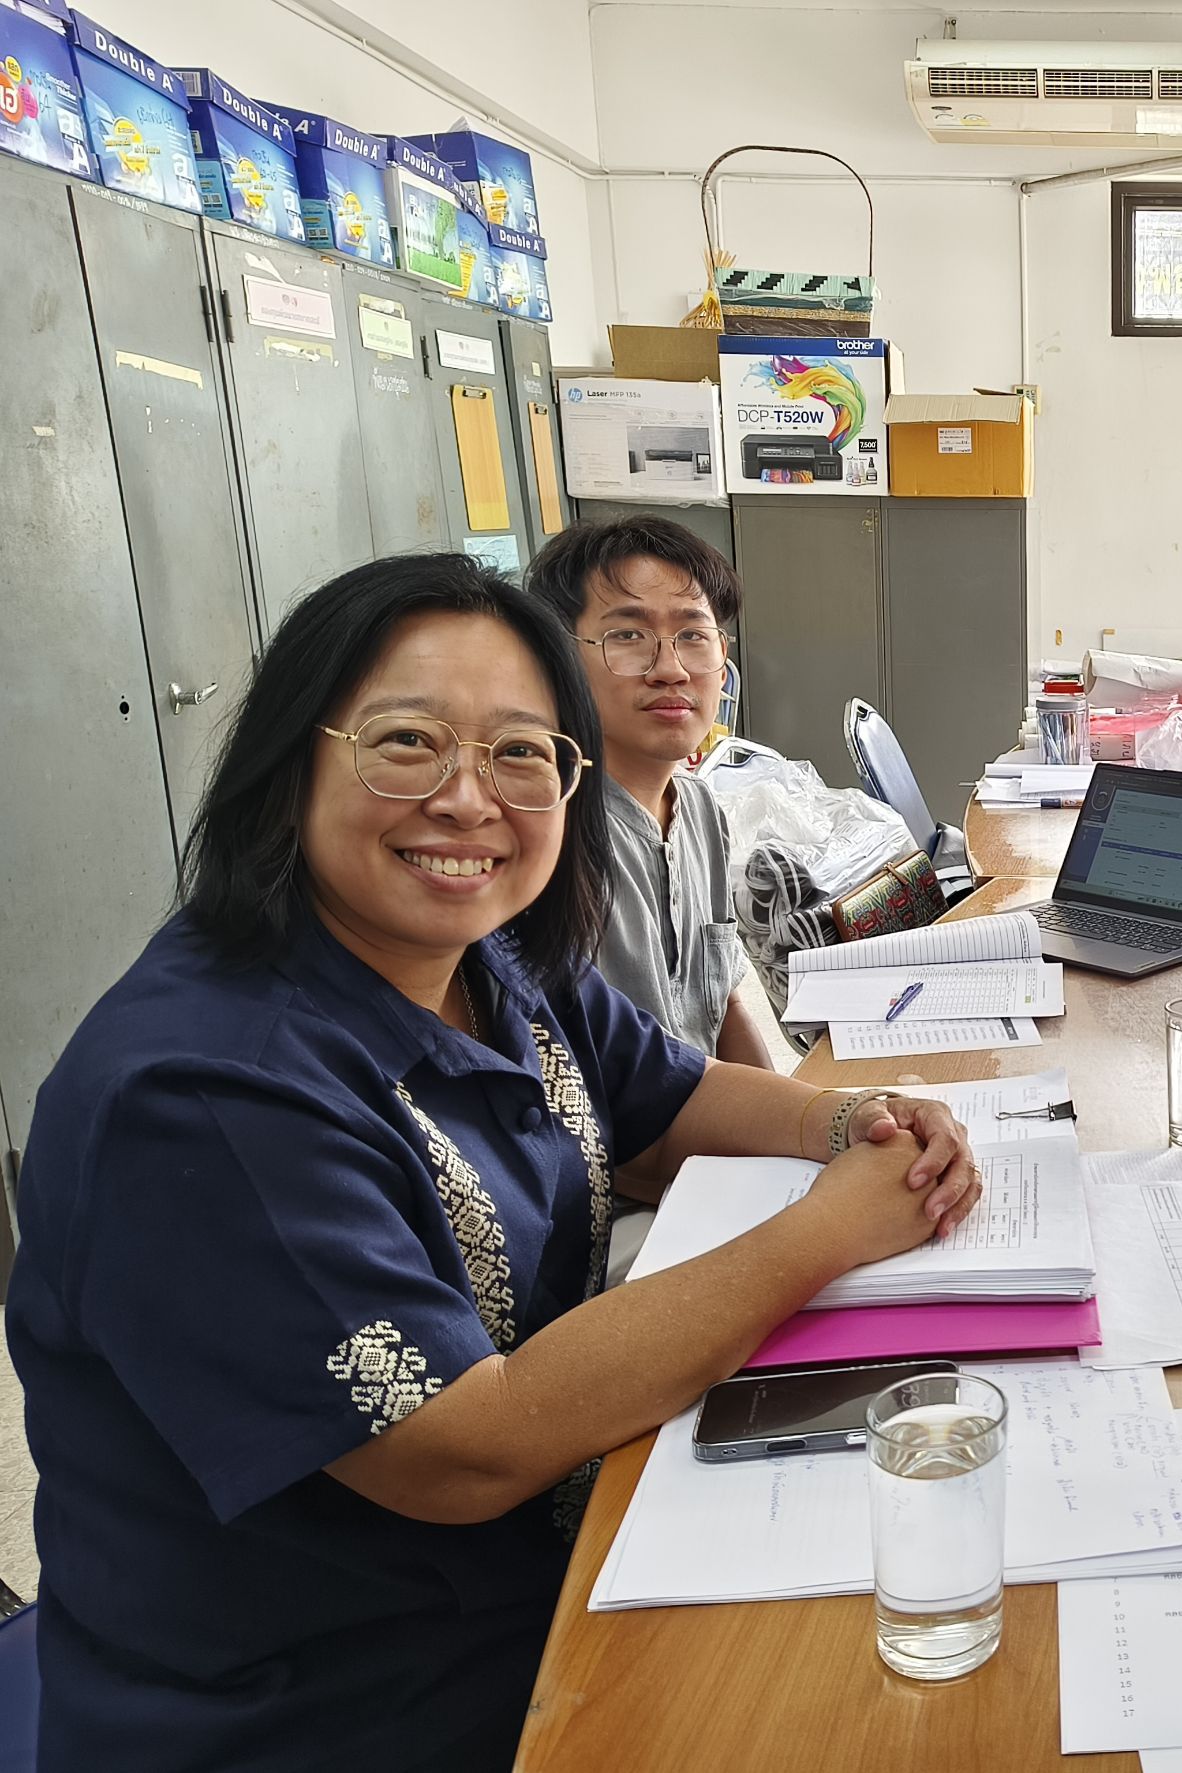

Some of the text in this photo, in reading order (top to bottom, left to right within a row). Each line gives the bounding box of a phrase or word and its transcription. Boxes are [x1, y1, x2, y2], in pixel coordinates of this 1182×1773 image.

[94, 31, 173, 93] Double A
[222, 87, 269, 131] Double
[272, 125, 283, 141] A
[335, 128, 378, 160] Double A
[403, 147, 445, 182] Double A
[500, 229, 540, 251] Double A
[836, 340, 874, 350] brother
[568, 387, 583, 403] hp
[738, 409, 824, 424] DCP-T520W
[1113, 1613, 1126, 1621] 10
[1114, 1626, 1126, 1634] 11
[1116, 1639, 1128, 1647] 12
[1116, 1653, 1129, 1661] 13
[1118, 1666, 1131, 1674] 14
[1120, 1680, 1132, 1689] 15
[1121, 1694, 1134, 1702] 16
[1122, 1709, 1135, 1718] 17
